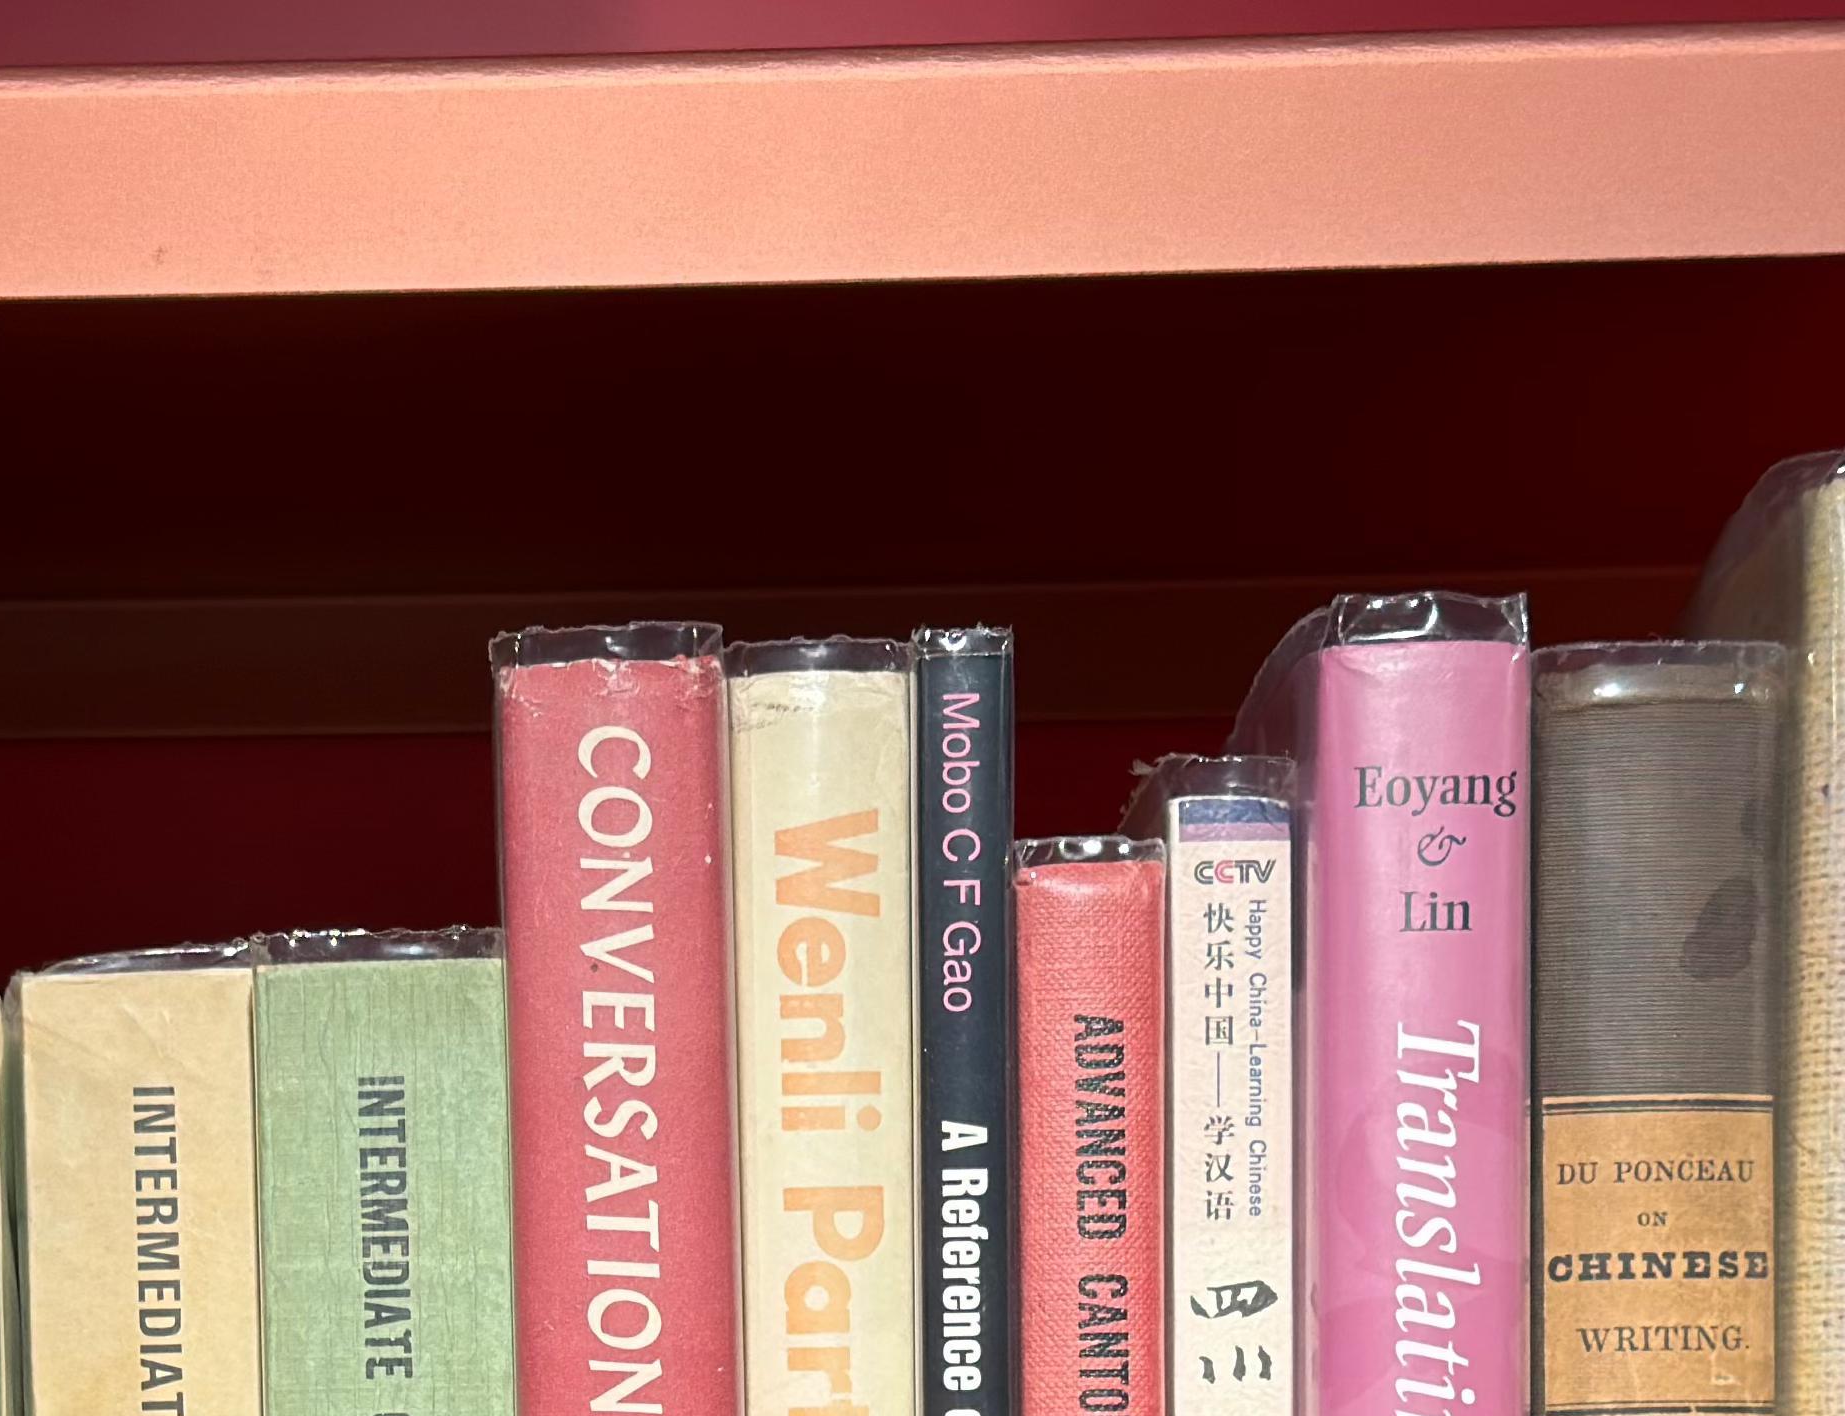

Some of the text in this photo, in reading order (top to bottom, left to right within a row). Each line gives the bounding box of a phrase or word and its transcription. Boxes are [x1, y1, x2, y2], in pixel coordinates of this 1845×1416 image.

[1353, 765, 1519, 818] Eoyang
[941, 692, 983, 1013] Mobo C F Gao
[1193, 858, 1277, 885] CCTV
[1415, 825, 1467, 867] &
[1244, 899, 1268, 960] Happy
[1399, 890, 1473, 934] Lin
[772, 808, 885, 1132] Wenli
[940, 1120, 989, 1152] A
[1073, 1013, 1128, 1241] ADVANCED
[1248, 1139, 1268, 1217] Chinese
[1556, 1158, 1757, 1186] DU PONCEAU
[356, 1073, 413, 1381] INTERMEDIATE
[1636, 1210, 1669, 1228] ON
[940, 1167, 990, 1392] Reference
[1547, 1249, 1771, 1283] CHINESE
[1189, 1279, 1280, 1384] 四川
[1575, 1324, 1751, 1353] WRITING.
